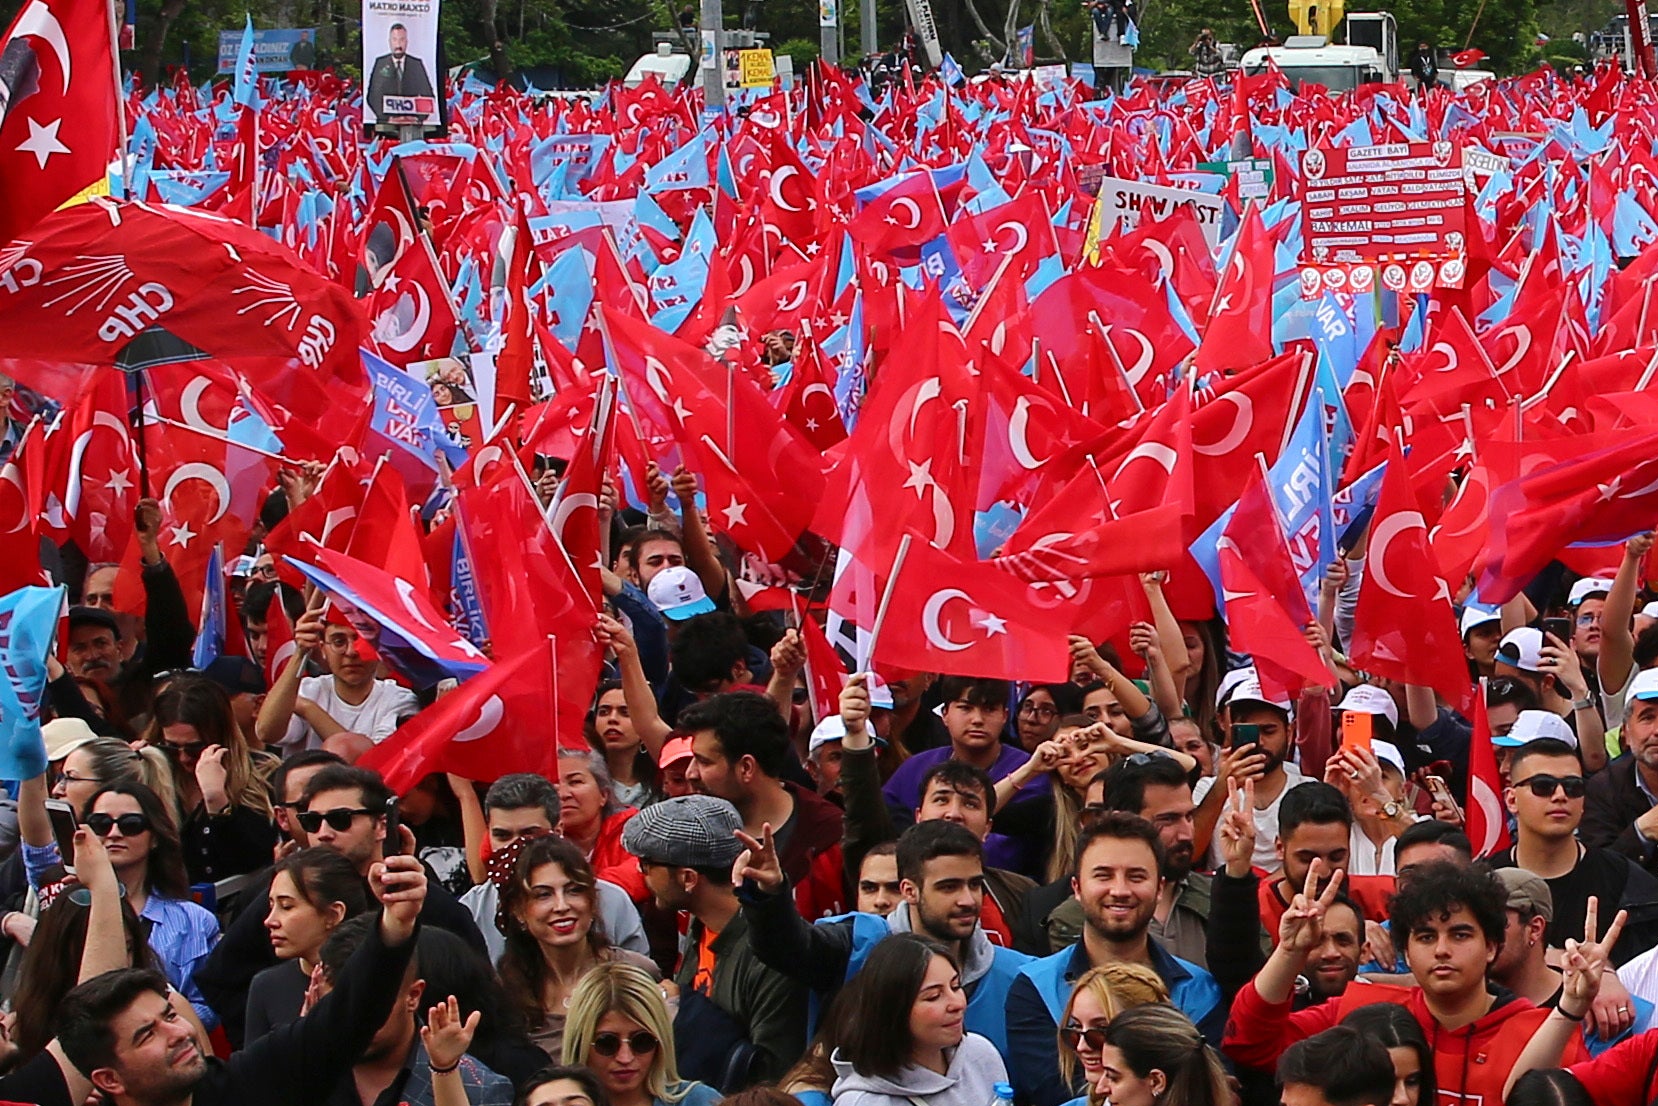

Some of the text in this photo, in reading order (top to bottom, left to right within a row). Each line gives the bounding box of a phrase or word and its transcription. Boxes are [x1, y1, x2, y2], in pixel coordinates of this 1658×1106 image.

[1350, 149, 1382, 158] GAZETE
[1115, 191, 1168, 215] SHW
[1315, 296, 1346, 342] VAR
